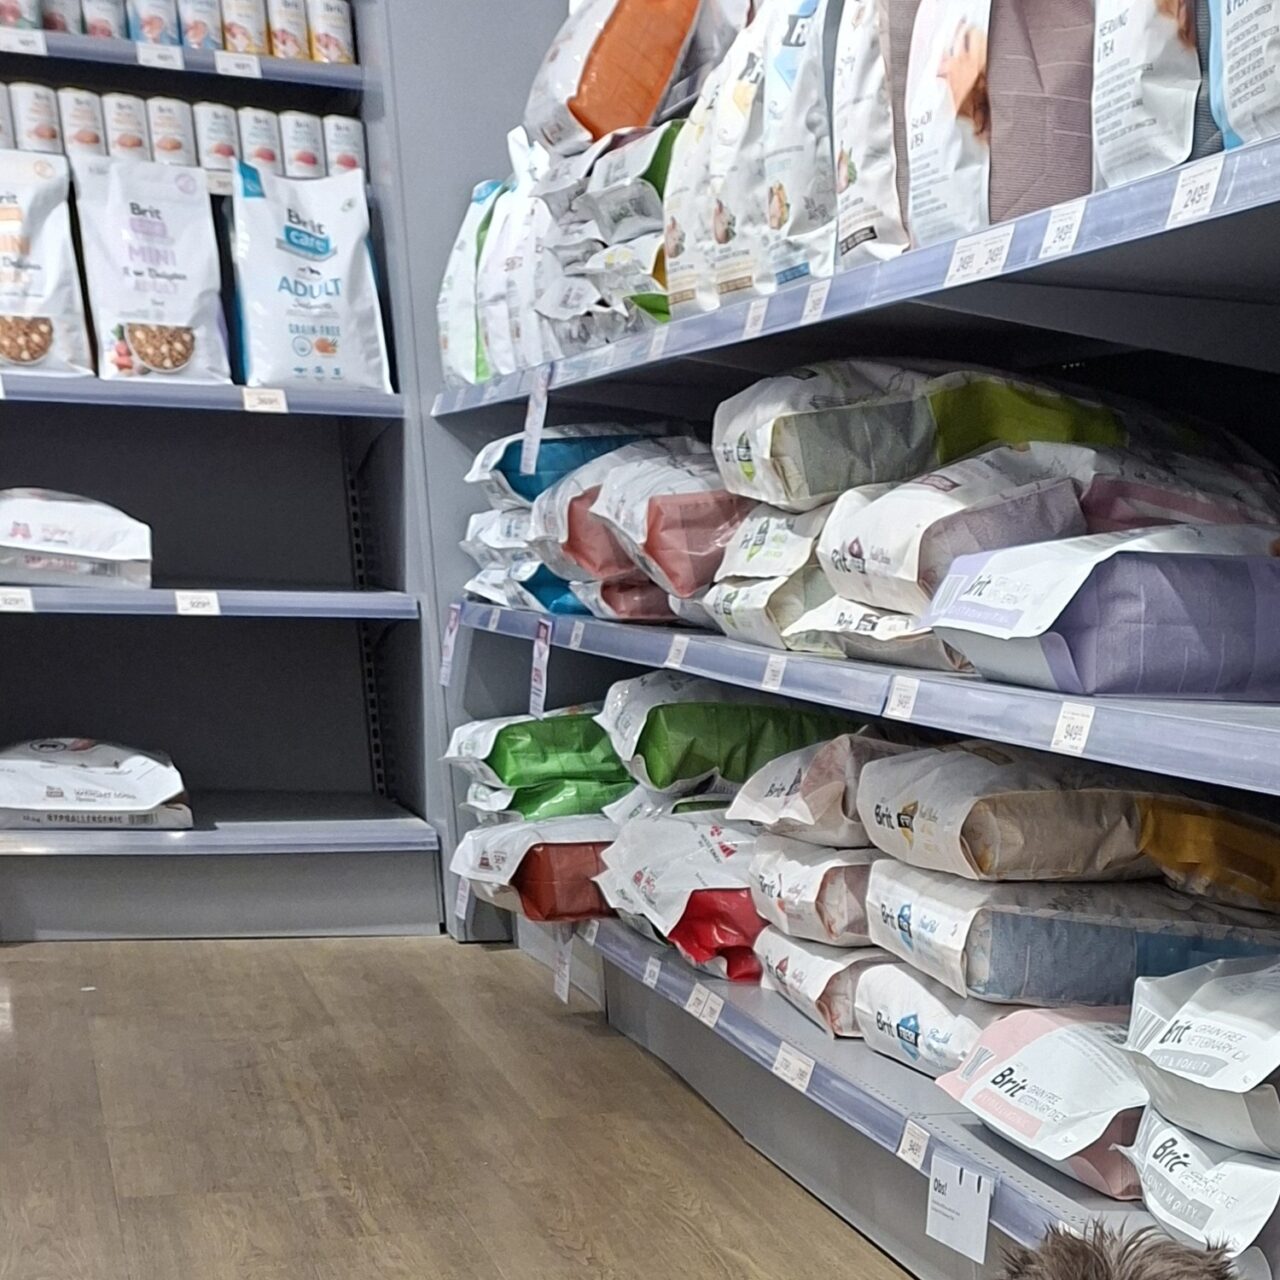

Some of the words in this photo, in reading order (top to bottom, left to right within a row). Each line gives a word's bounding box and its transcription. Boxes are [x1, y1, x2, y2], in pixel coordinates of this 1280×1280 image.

[129, 202, 162, 220] Brit
[287, 208, 325, 235] Brit
[278, 276, 341, 299] ADULT
[874, 804, 895, 830] Brit
[881, 903, 897, 930] Brit
[876, 1011, 895, 1038] Brit
[990, 1067, 1028, 1098] Brit
